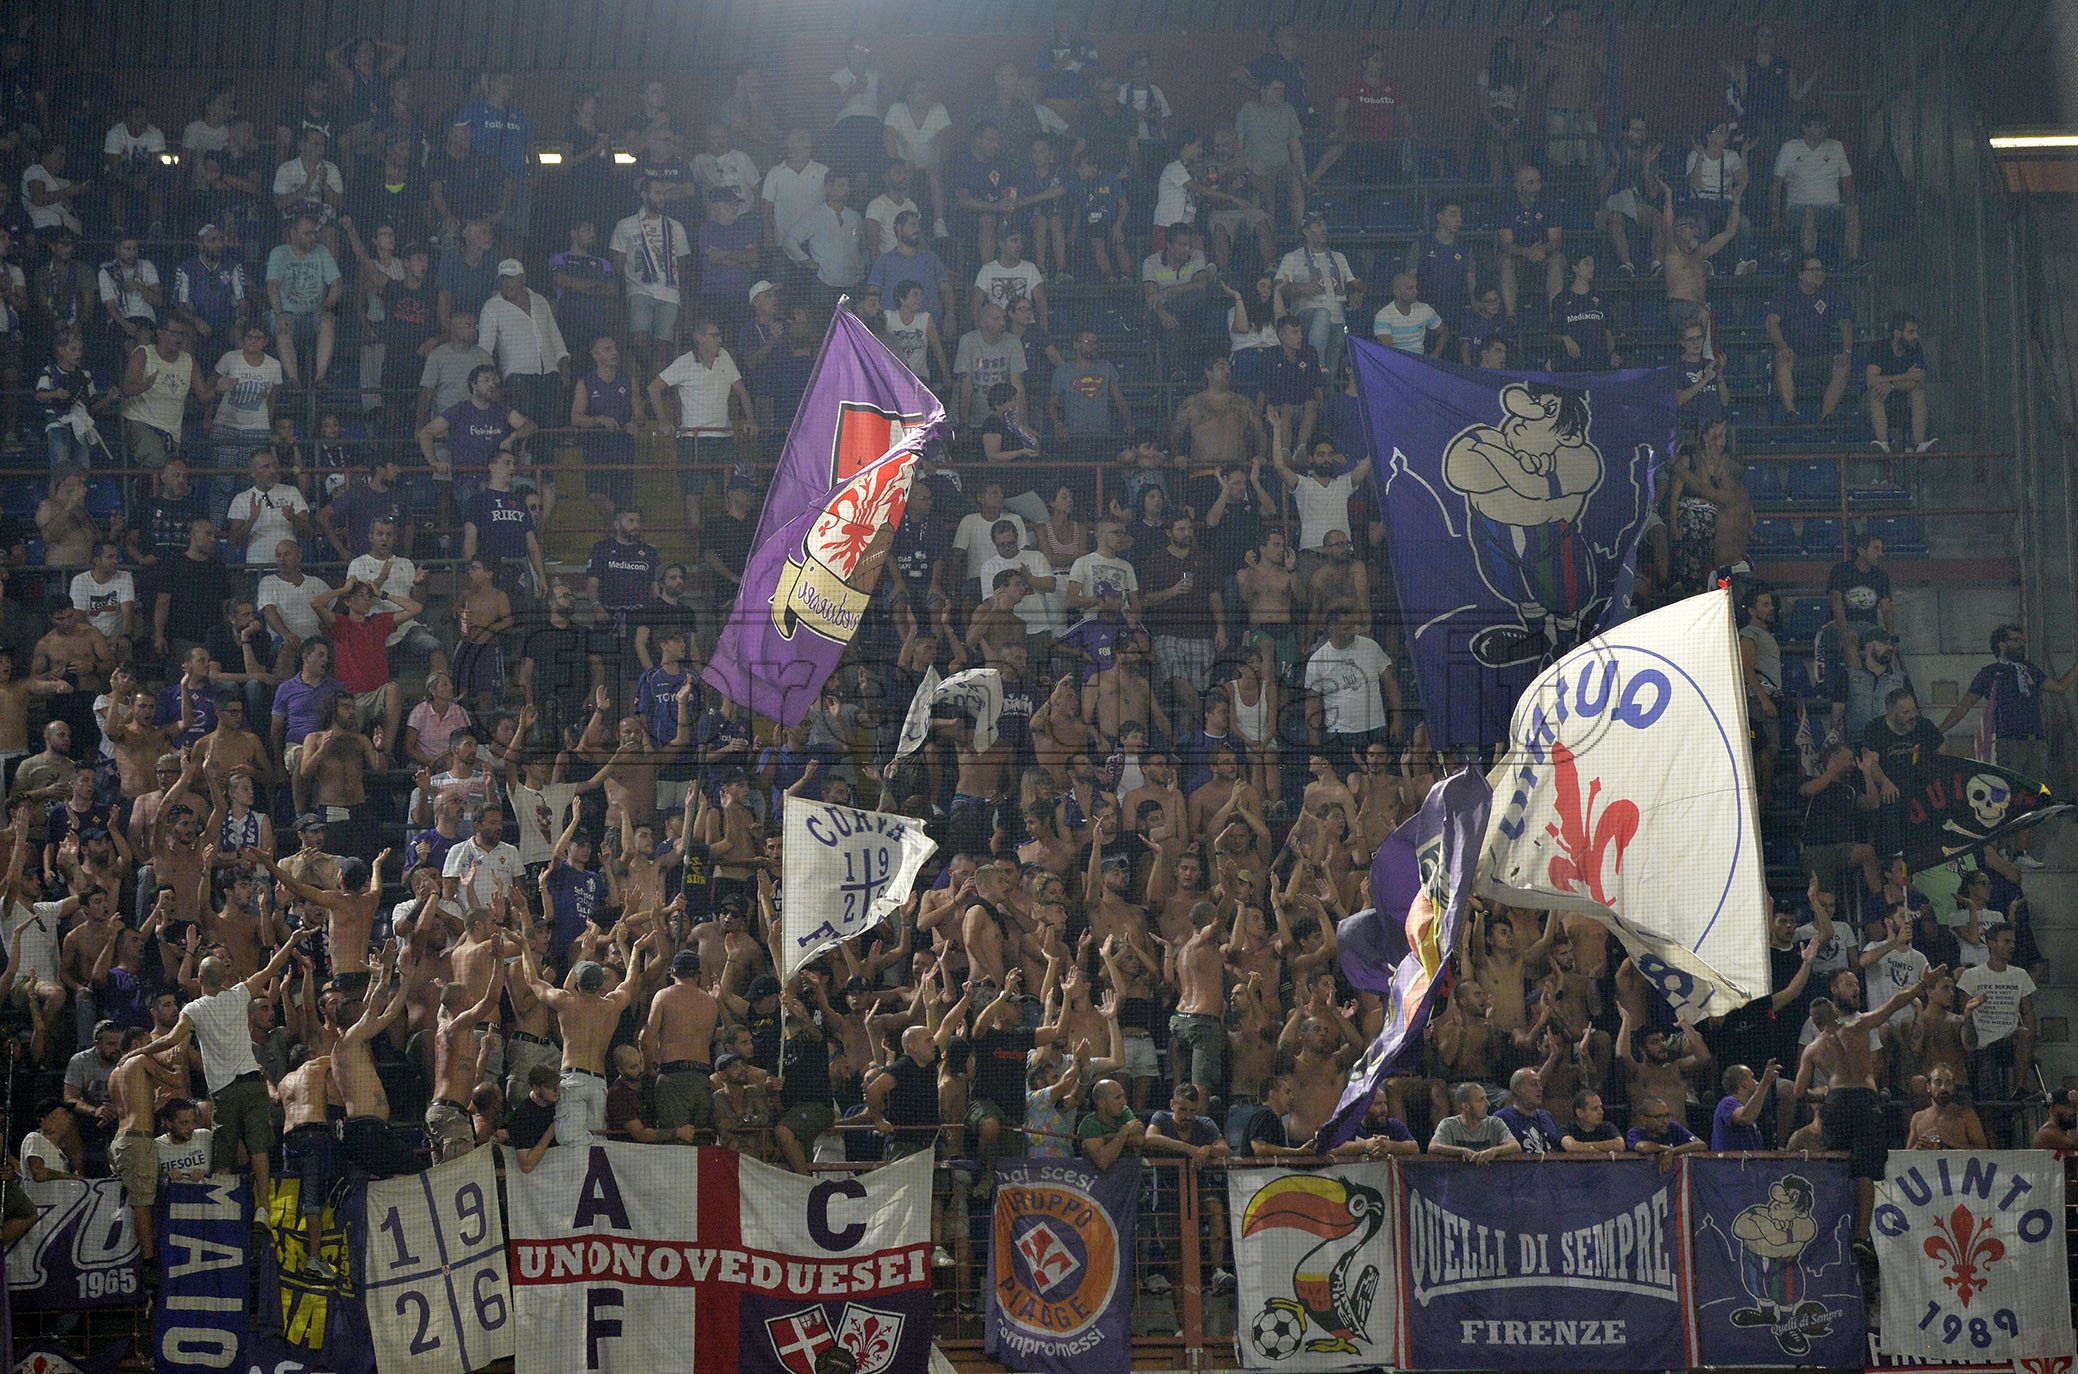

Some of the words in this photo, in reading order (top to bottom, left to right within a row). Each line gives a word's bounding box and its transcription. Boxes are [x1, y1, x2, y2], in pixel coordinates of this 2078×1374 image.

[491, 509, 525, 522] RIKY
[608, 560, 647, 571] Mediacom
[1040, 1164, 1099, 1193] scesi
[1875, 1156, 2053, 1244] QUINTO
[1410, 1188, 1508, 1306] QUELLI
[1519, 1233, 1551, 1274] DI
[1561, 1186, 1673, 1287] SEMPRE
[75, 1268, 137, 1299] 1965
[162, 1173, 244, 1369] MAIO
[517, 1241, 926, 1296] UNONOVEDUESEI
[1460, 1319, 1628, 1345] FIRENZE
[1771, 1315, 1797, 1335] Quelli
[1799, 1313, 1810, 1328] di
[1811, 1308, 1844, 1327] Sempre
[1918, 1300, 2020, 1349] 1989
